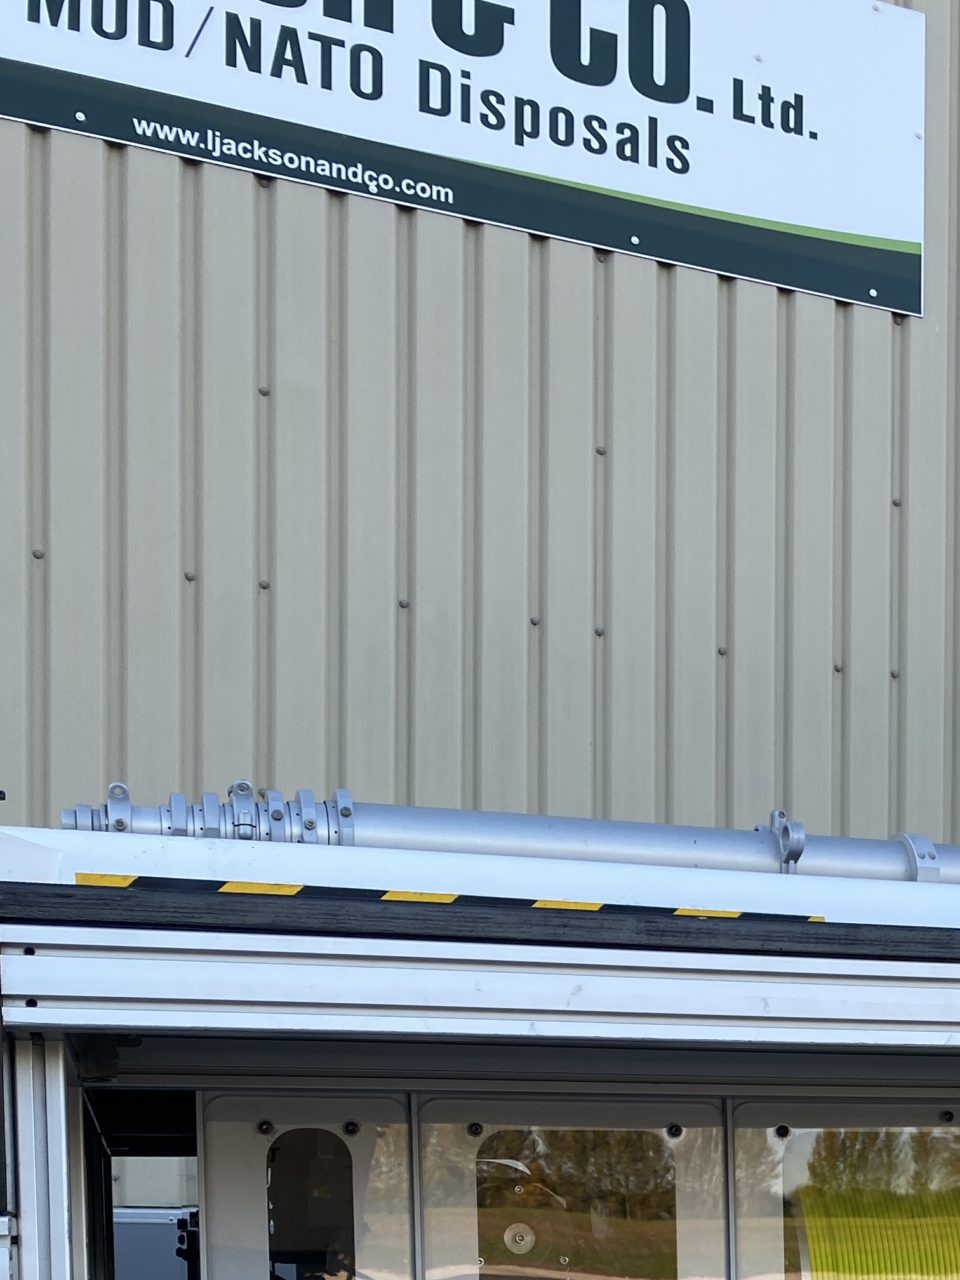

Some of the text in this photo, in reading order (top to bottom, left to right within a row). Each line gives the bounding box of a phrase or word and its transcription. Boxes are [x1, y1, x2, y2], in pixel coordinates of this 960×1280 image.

[418, 59, 691, 176] Disposals
[733, 77, 819, 141] Ltd.
[132, 117, 455, 205] www.ljacksonandco.com
